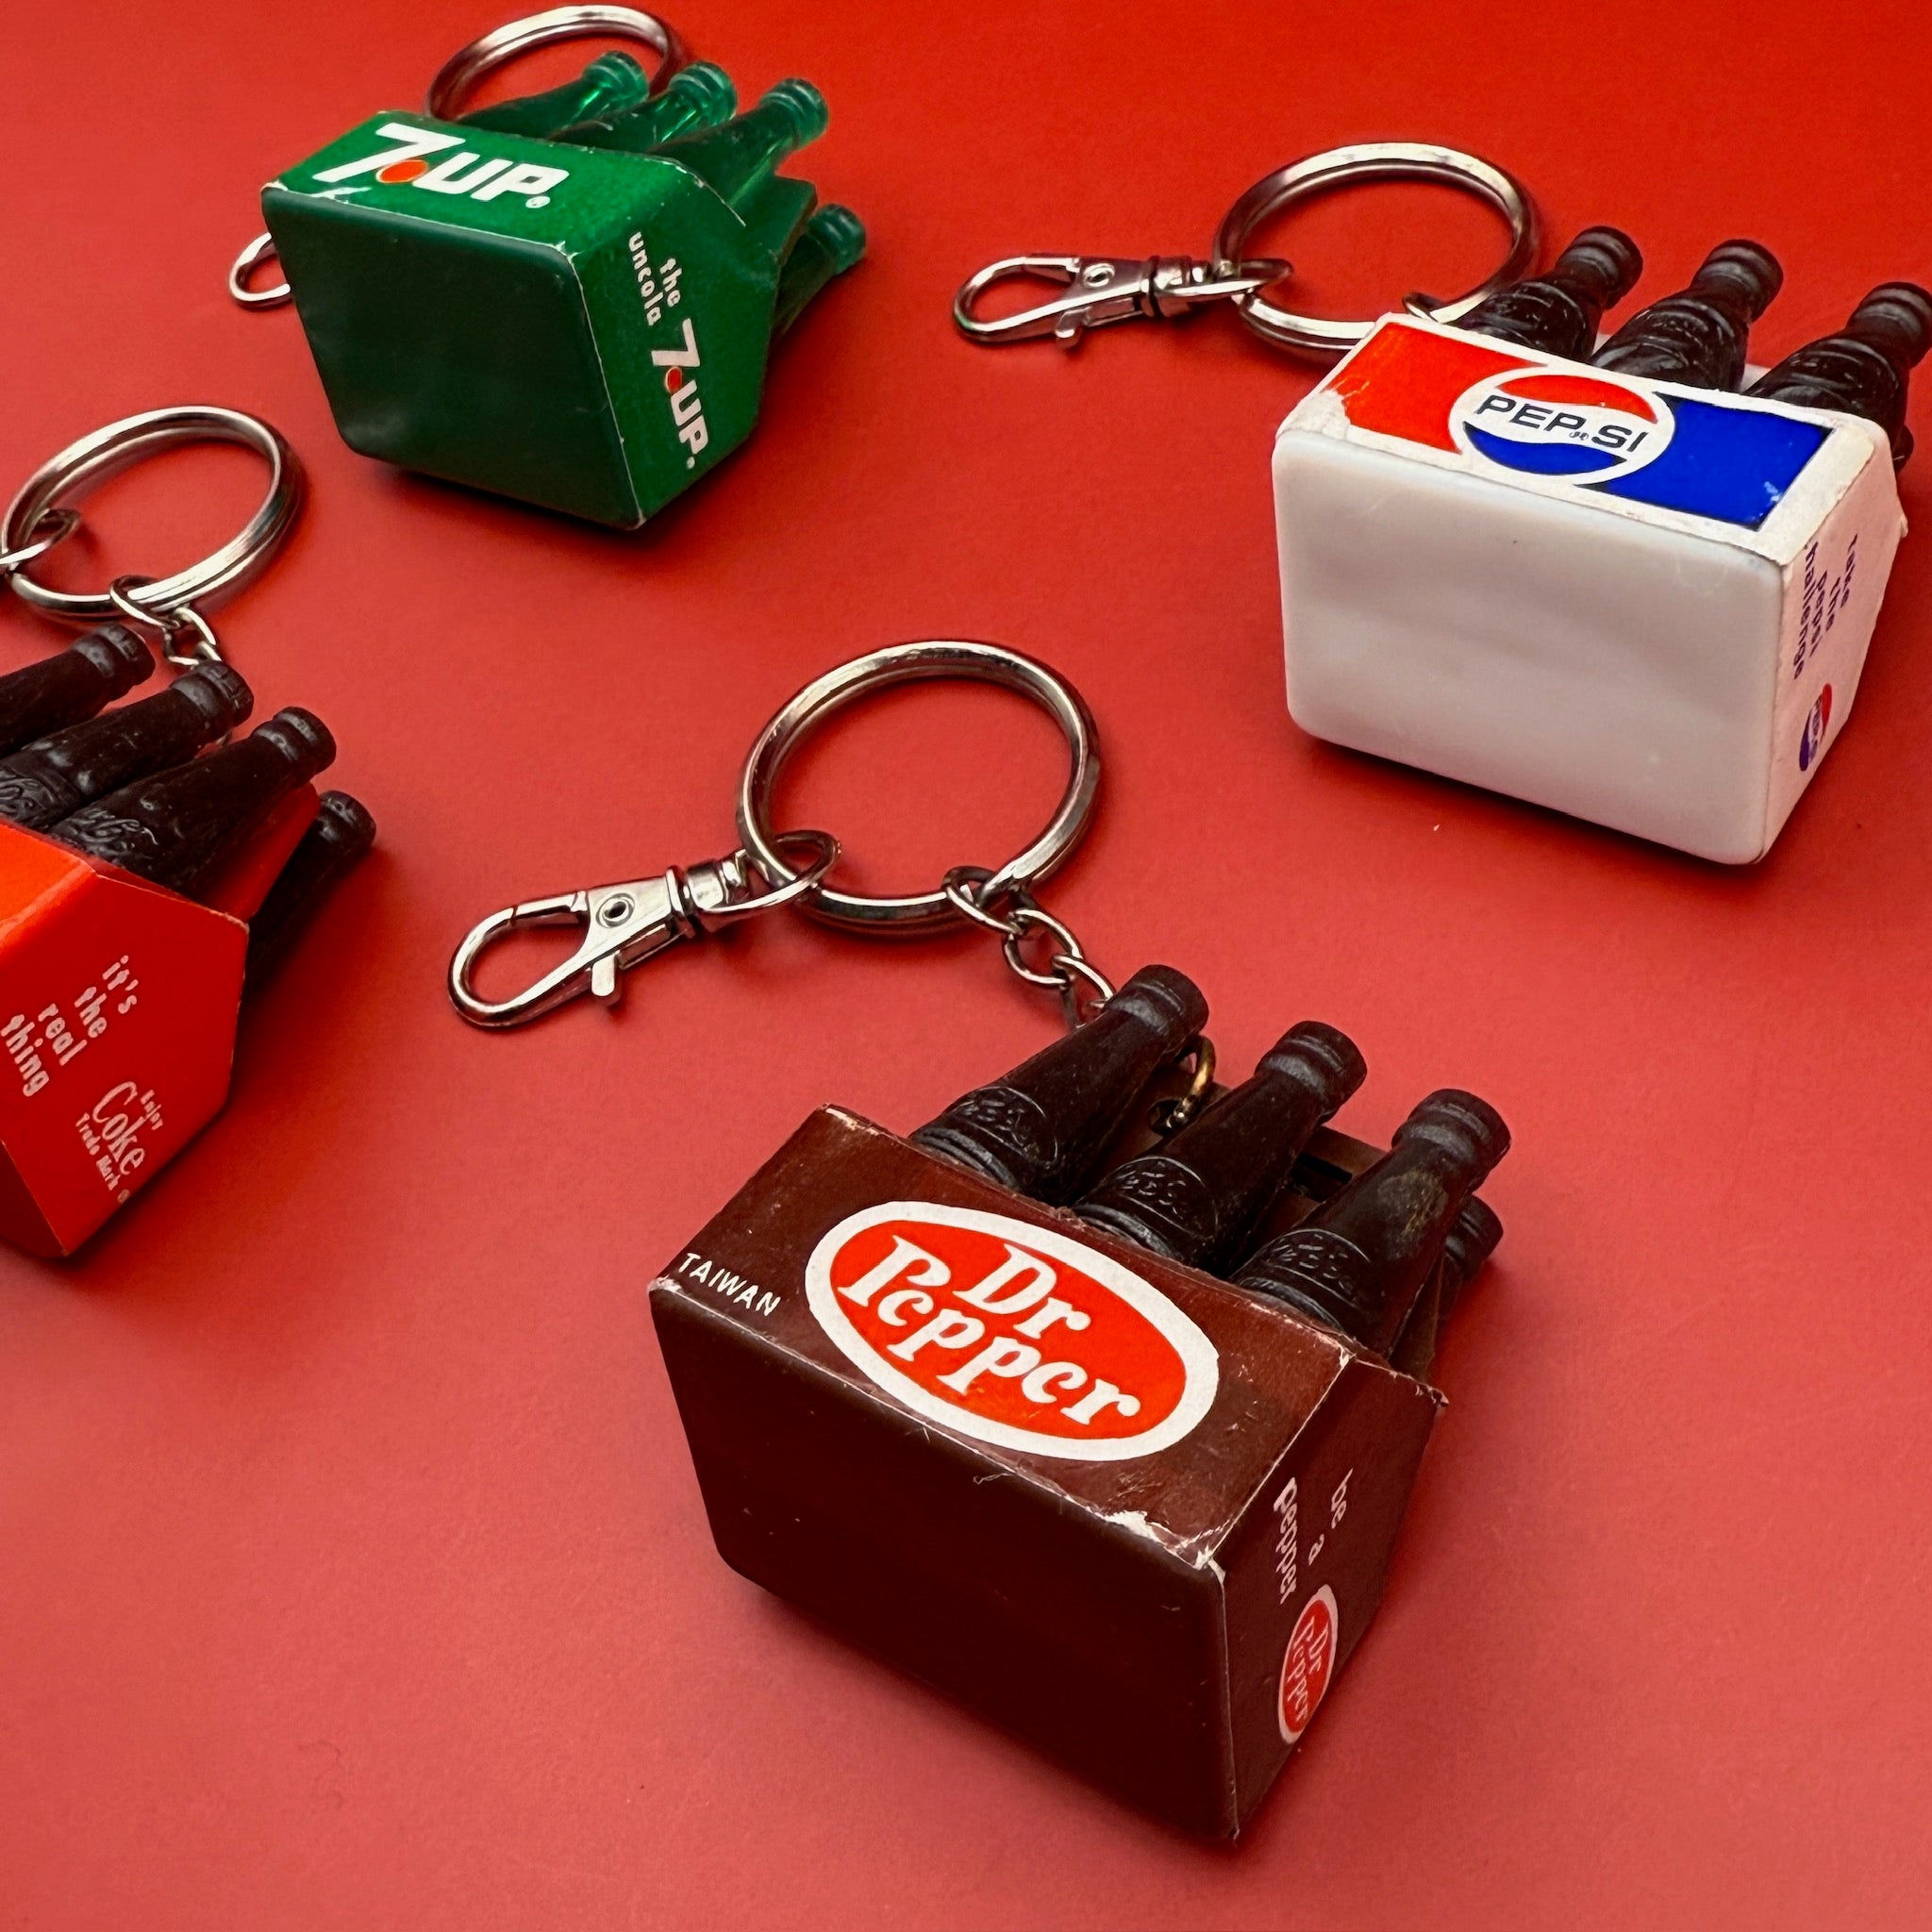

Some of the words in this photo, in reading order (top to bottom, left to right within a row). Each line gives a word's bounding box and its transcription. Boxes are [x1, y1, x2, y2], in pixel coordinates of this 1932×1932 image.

[628, 231, 664, 325] uncola
[659, 258, 682, 308] the
[1474, 394, 1649, 453] PEPSI
[1840, 533, 1858, 608] take
[1793, 541, 1818, 680] hallenge
[1825, 576, 1840, 632] the
[74, 987, 107, 1039] the
[102, 955, 139, 1014] it's
[0, 1014, 49, 1097] thing
[38, 1004, 88, 1066] real
[92, 1081, 146, 1175] Coke
[678, 1253, 781, 1317] TAIWAN
[952, 1243, 1091, 1340] Dr
[838, 1235, 1141, 1425] Pepper
[1331, 1468, 1354, 1529] be
[1274, 1476, 1297, 1605] pepper
[1307, 1534, 1324, 1566] a
[1308, 1623, 1328, 1674] Dr
